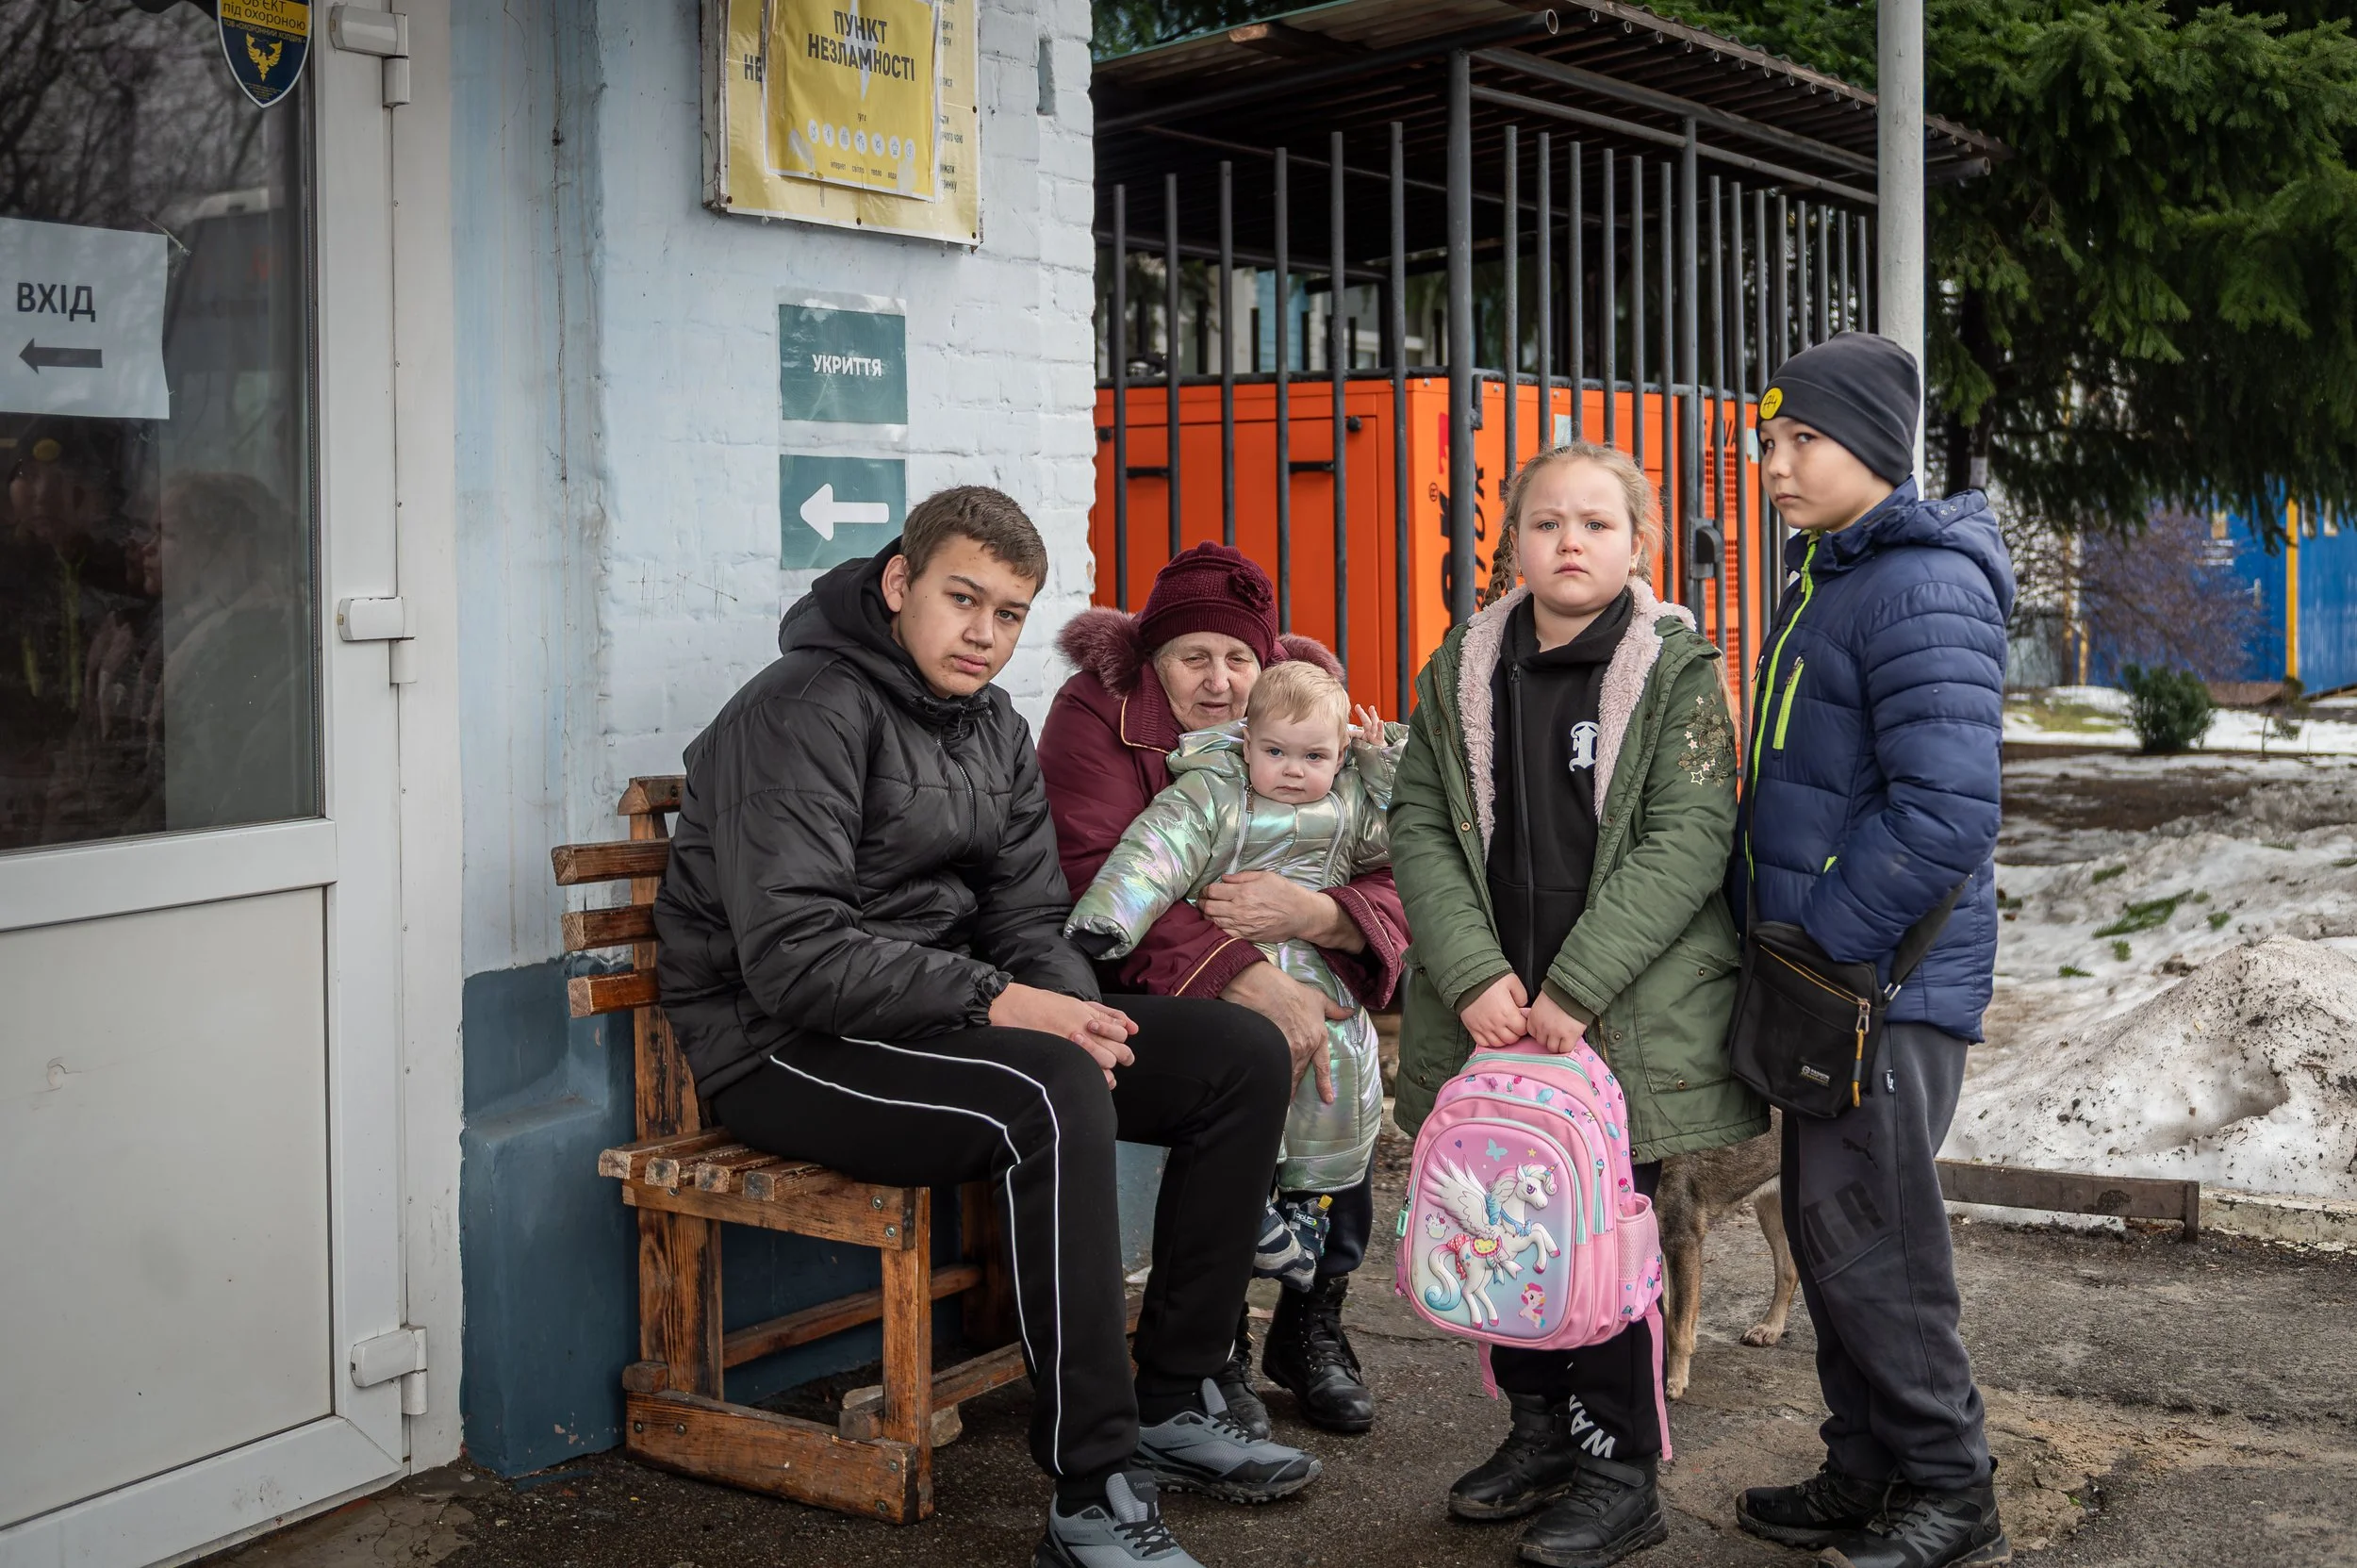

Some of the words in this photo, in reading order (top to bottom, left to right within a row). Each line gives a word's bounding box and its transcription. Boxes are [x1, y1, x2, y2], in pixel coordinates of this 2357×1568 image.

[223, 3, 241, 18] під
[245, 8, 305, 30] охороною
[833, 10, 887, 44] ПУНКТ
[808, 33, 915, 81] НЕЗЛАМНОСТІ
[17, 282, 96, 322] ВХІД
[812, 354, 882, 377] УКРИТТЯ
